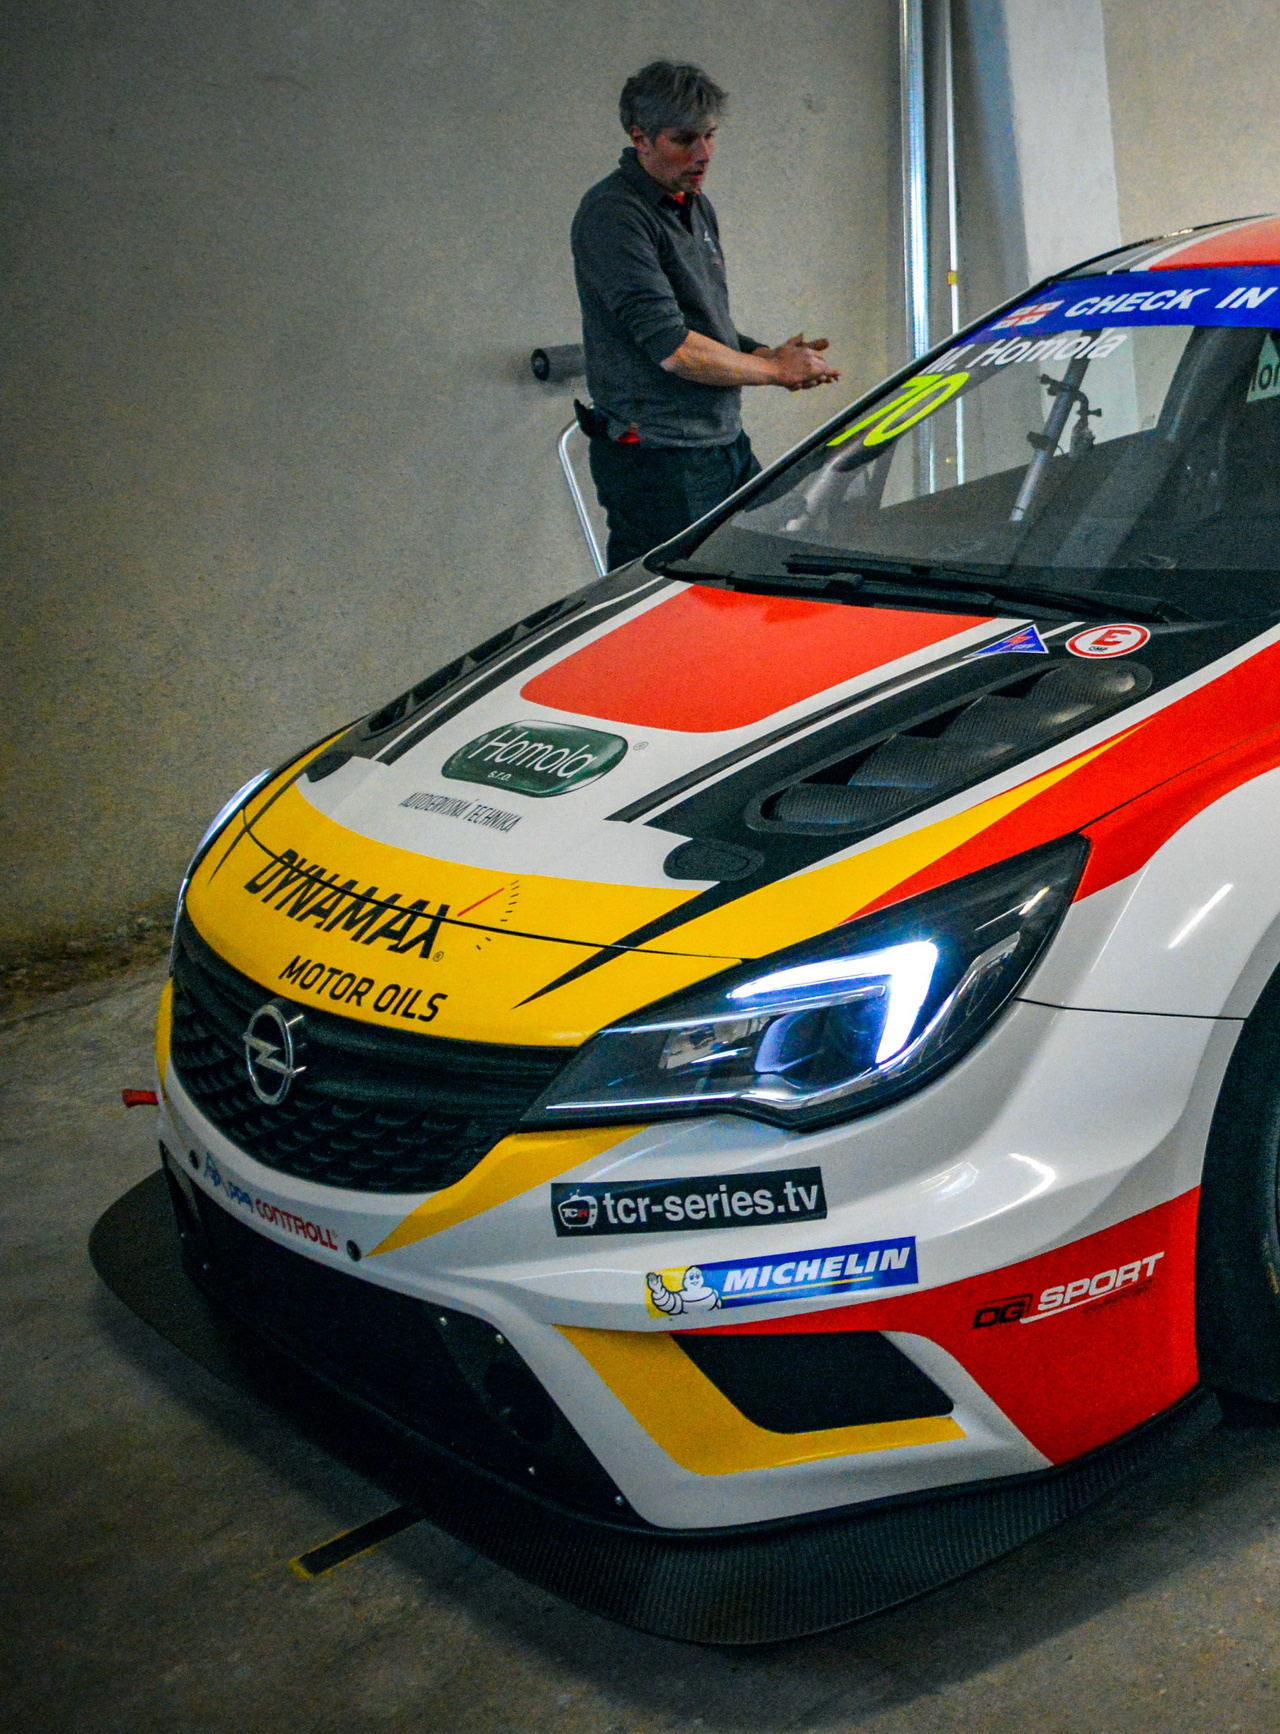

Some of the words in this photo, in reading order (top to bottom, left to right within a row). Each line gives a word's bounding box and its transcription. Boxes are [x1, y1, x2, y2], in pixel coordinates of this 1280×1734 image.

[1064, 287, 1210, 318] CHECK
[1214, 286, 1279, 310] IN
[917, 343, 975, 376] M.
[965, 332, 1129, 369] Homola
[826, 371, 969, 447] 70
[1091, 629, 1132, 646] E
[468, 729, 597, 779] Homola
[243, 848, 450, 959] DYNAMAX
[278, 955, 375, 1007] MOTOR
[373, 983, 449, 1022] OILS
[603, 1181, 818, 1224] tcr-series.tv
[723, 1247, 910, 1292] MICHELIN
[972, 1301, 1026, 1329] DG
[1038, 1251, 1164, 1311] SPORT
